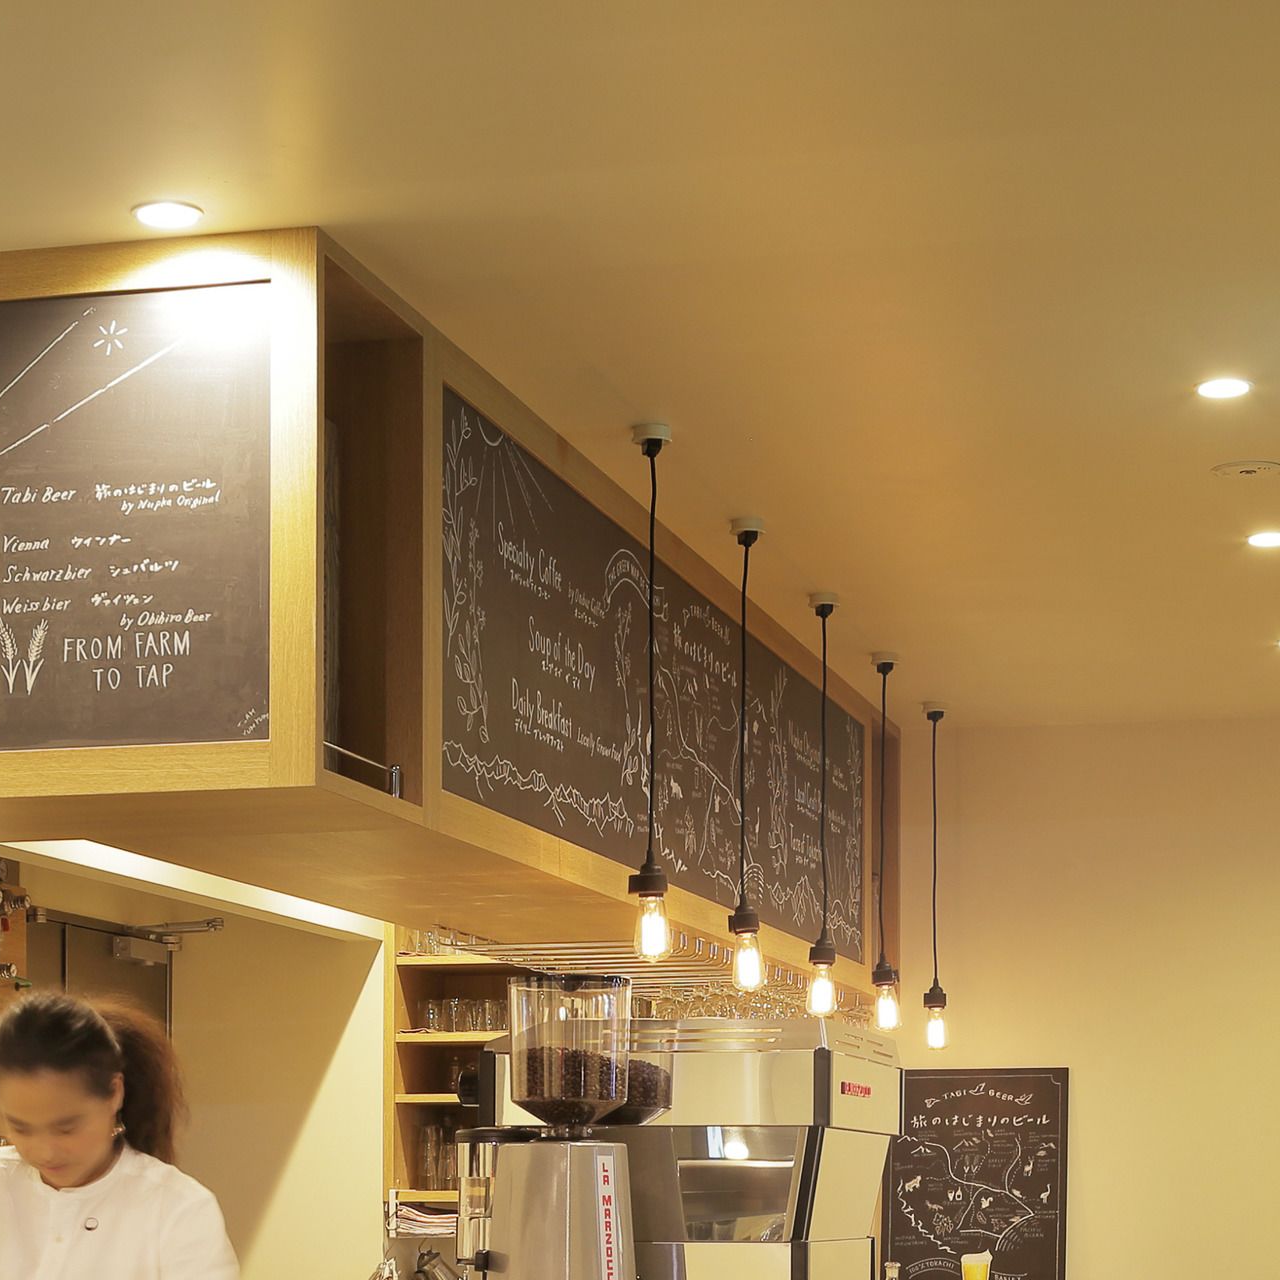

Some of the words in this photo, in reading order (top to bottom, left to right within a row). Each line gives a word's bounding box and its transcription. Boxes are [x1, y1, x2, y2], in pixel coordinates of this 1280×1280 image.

[1, 486, 38, 505] Tabi
[41, 486, 77, 503] Beer
[120, 500, 135, 515] by
[176, 489, 221, 508] Original
[3, 535, 50, 553] Vienna
[498, 521, 535, 582] Specialty
[538, 548, 562, 592] Coffee
[2, 564, 92, 584] Schwarzbier
[120, 613, 134, 631] by
[136, 611, 182, 627] Obihiro
[183, 608, 212, 625] Beer
[63, 635, 122, 663] FROM
[135, 630, 191, 658] FARM
[528, 615, 552, 664] Soup
[553, 631, 562, 661] of
[564, 636, 576, 671] the
[577, 642, 596, 693] Day
[92, 667, 121, 692] TO
[135, 663, 175, 688] TAP
[511, 677, 535, 731] Daily
[536, 690, 572, 739] Breakfast
[987, 1088, 1014, 1102] BEER
[910, 1113, 1051, 1129] 旅のはじまりのビール
[601, 1162, 610, 1186] LA
